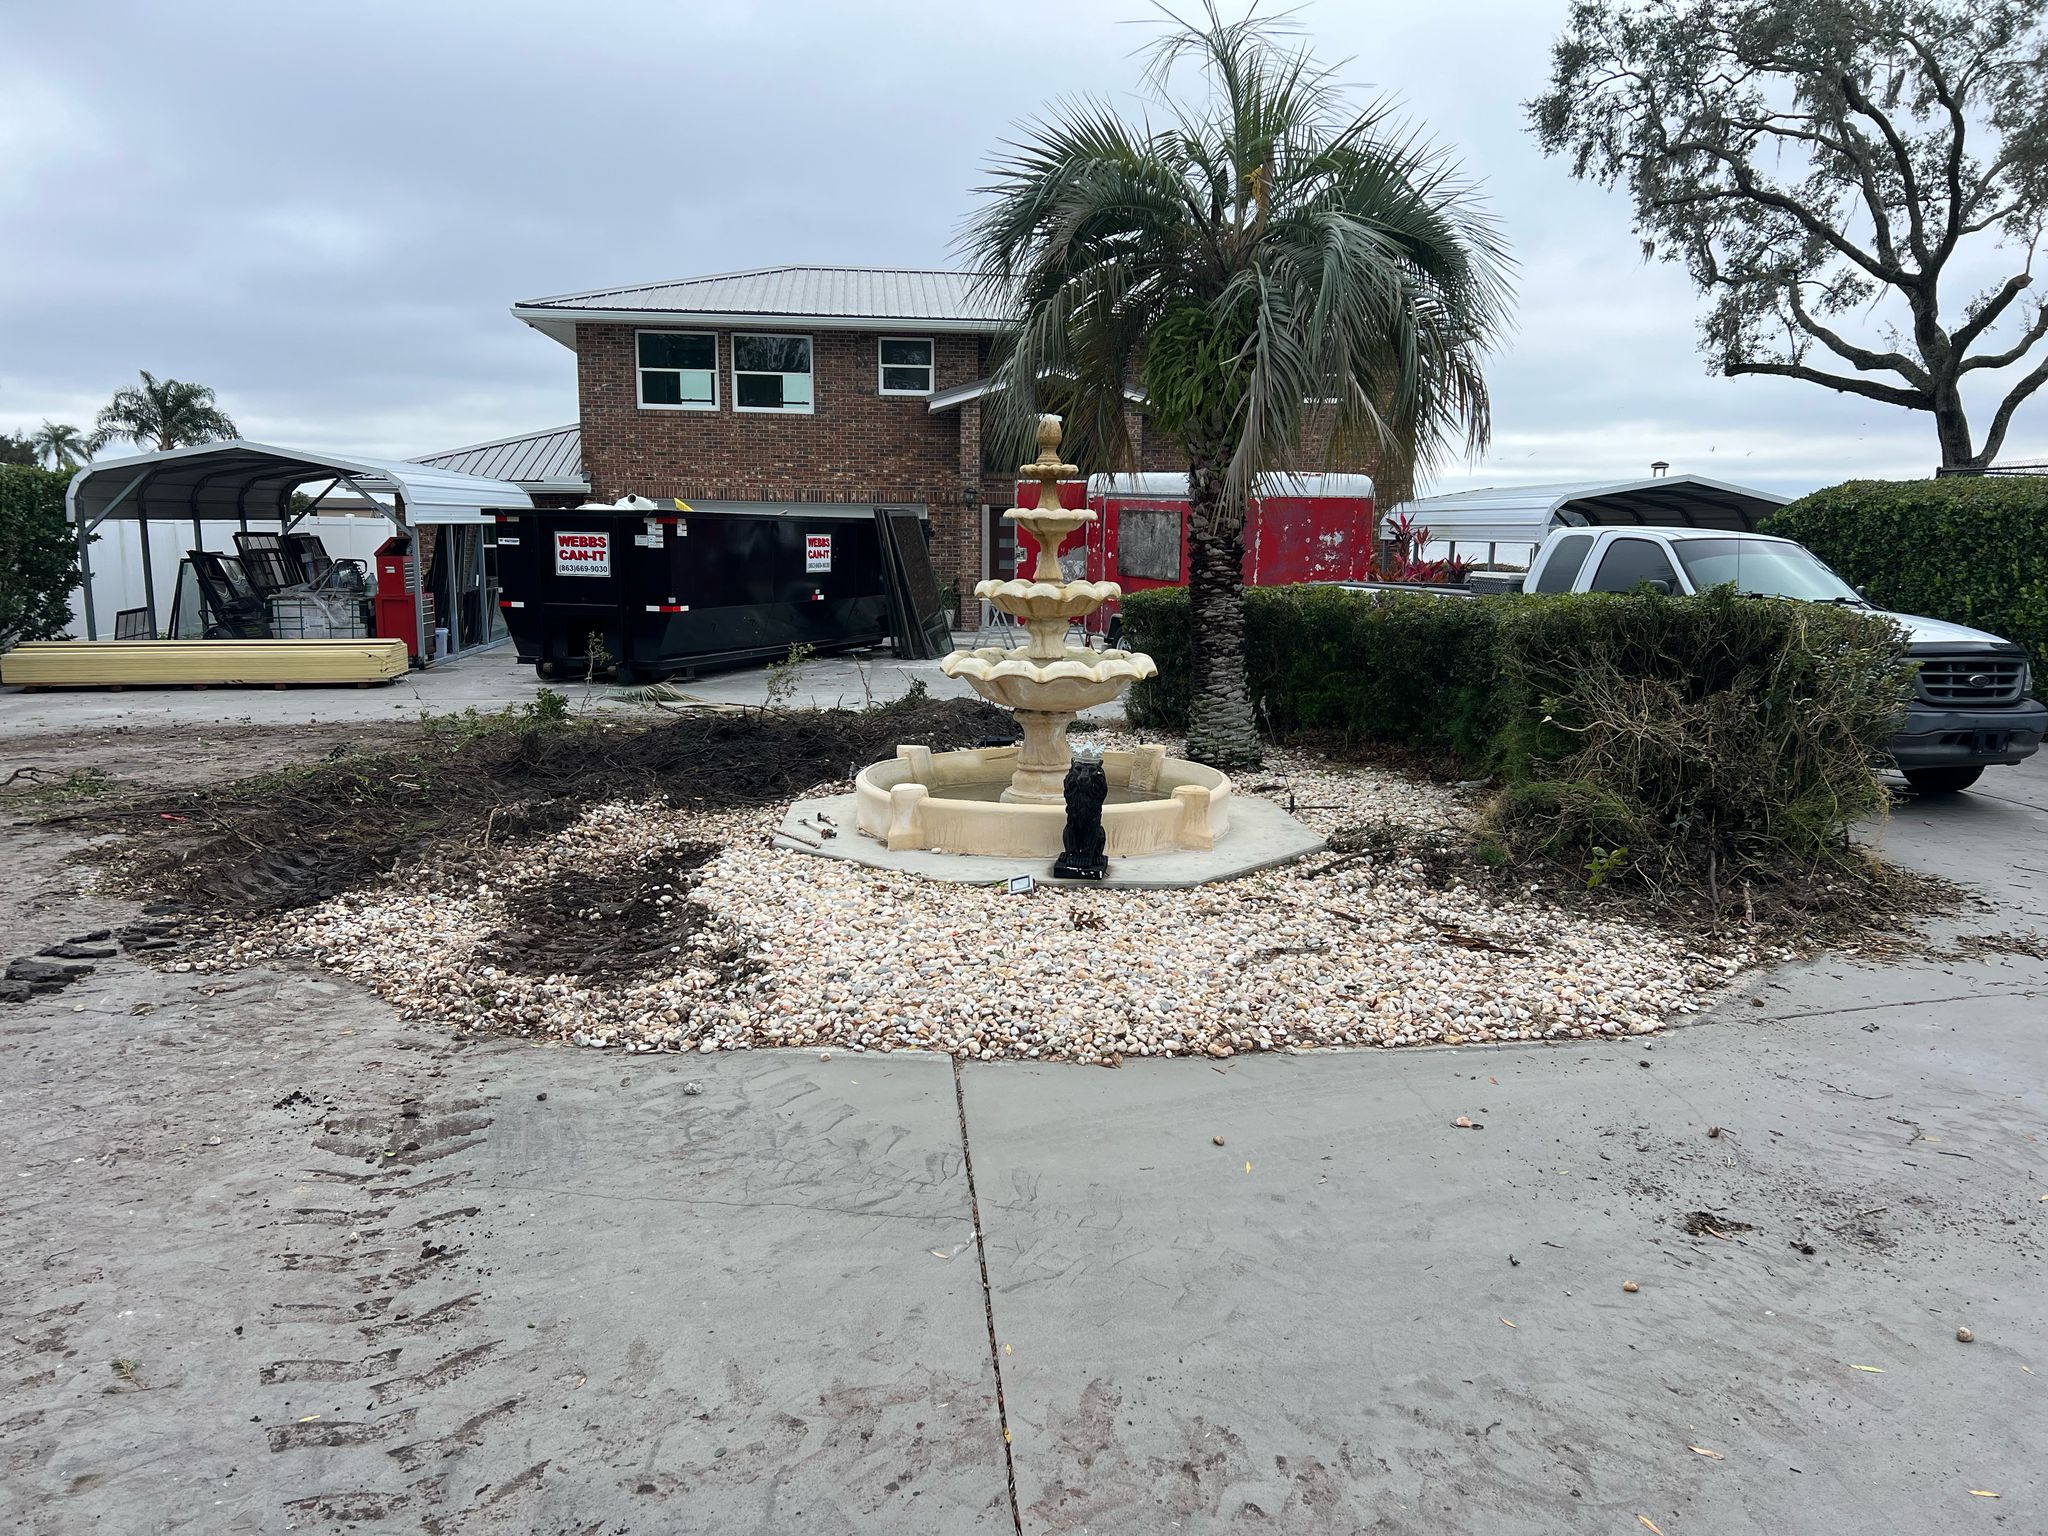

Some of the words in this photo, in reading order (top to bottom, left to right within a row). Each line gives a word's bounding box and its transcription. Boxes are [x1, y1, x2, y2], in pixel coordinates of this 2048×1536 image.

[558, 535, 607, 548] WEBBS
[808, 537, 830, 547] WEBBS
[559, 549, 606, 561] CAN-IT
[808, 549, 830, 559] CAN-IT
